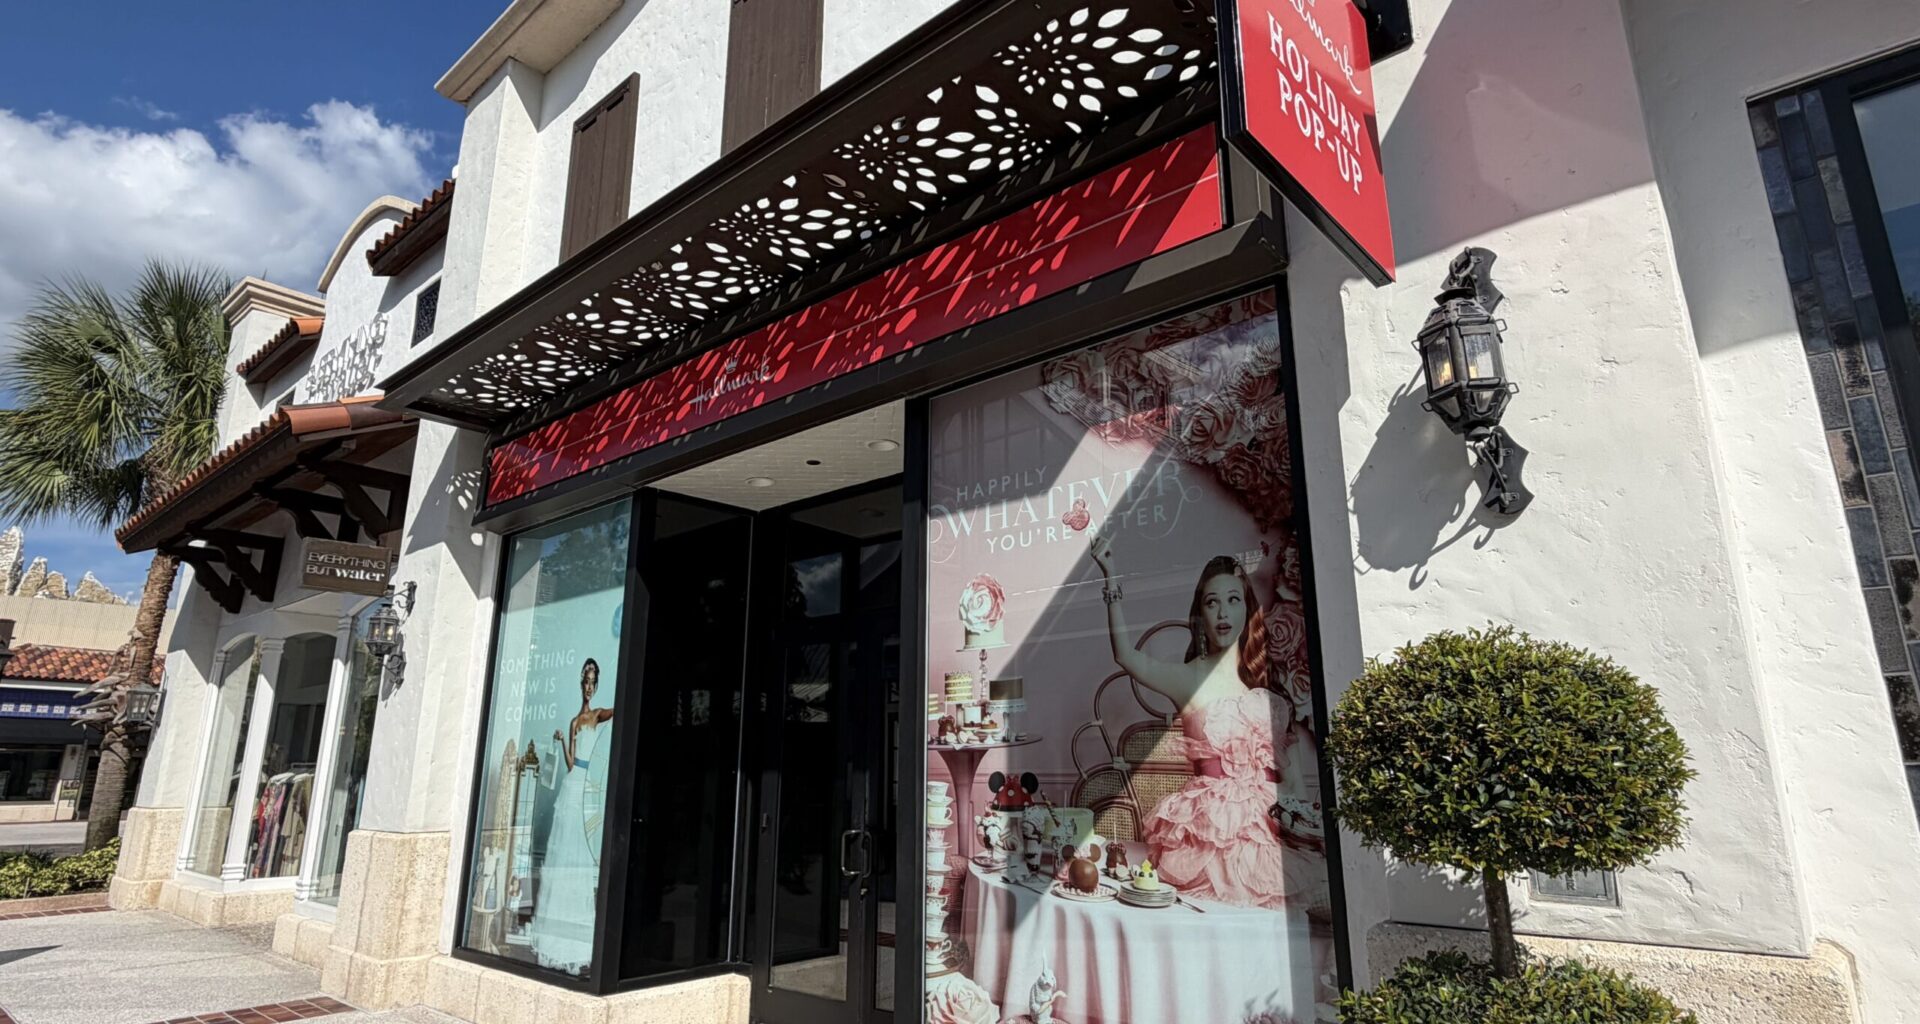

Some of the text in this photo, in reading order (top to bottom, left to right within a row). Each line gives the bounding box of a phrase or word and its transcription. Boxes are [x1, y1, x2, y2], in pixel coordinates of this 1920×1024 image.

[1267, 11, 1361, 156] HOLIDAY
[1276, 68, 1363, 196] POP-UP
[688, 354, 777, 415] Hallmark
[956, 465, 1048, 502] HAPPILY
[929, 459, 1202, 556] WHATEVER
[986, 504, 1167, 554] YOU'RE AFTER
[306, 564, 385, 582] BUT water
[308, 552, 386, 569] EVERYTHING
[500, 649, 575, 674] SOMETHING
[510, 677, 556, 698] NEW IS
[504, 701, 557, 723] COMING
